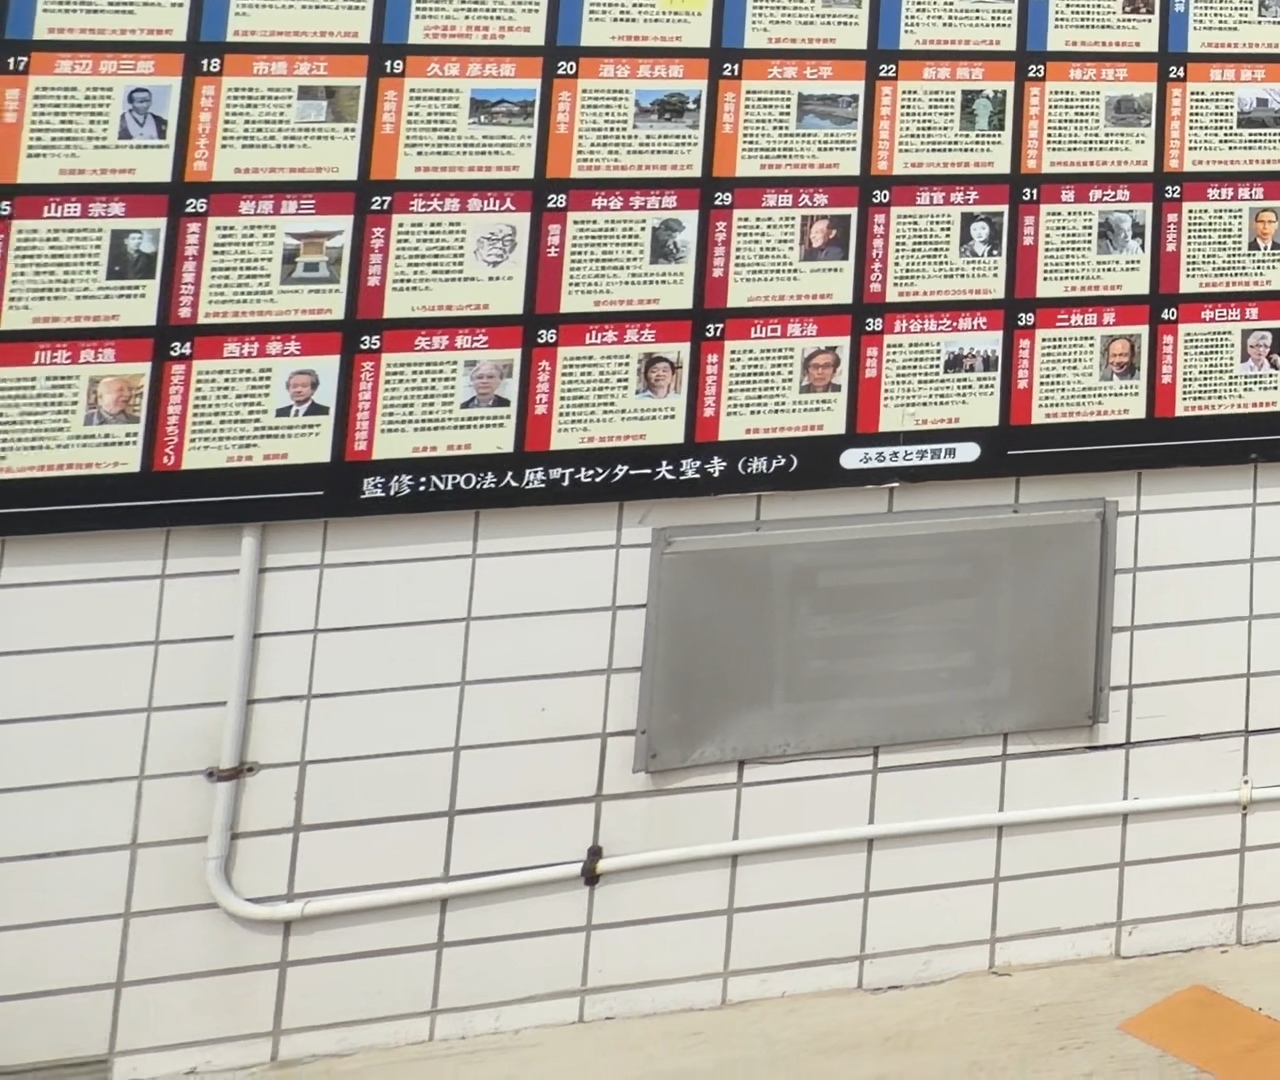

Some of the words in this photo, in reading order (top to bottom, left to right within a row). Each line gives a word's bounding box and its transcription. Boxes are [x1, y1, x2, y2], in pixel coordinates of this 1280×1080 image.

[6, 56, 29, 72] 17
[98, 60, 155, 74] 卯三郎
[200, 58, 221, 72] 18
[252, 61, 287, 75] 市橋
[294, 61, 328, 75] 波江
[384, 60, 403, 74] 19
[426, 63, 460, 77] 久保
[466, 63, 516, 77] 彦兵衛
[558, 61, 576, 74] 20
[722, 63, 739, 76] 21
[636, 64, 683, 78] 長兵衛
[768, 66, 798, 79] 大家
[802, 66, 833, 79] 七平
[879, 65, 896, 77] 22
[922, 66, 951, 80] 新家
[956, 67, 985, 80] 熊吉
[1028, 65, 1045, 77] 23
[1100, 68, 1128, 81] 理平
[1169, 66, 1185, 79] 24
[714, 192, 732, 205] 29
[872, 190, 889, 203] 30
[950, 191, 979, 204] 咲子
[1023, 188, 1038, 200] 31
[1164, 186, 1181, 198] 32
[1207, 188, 1234, 200] 牧野
[1238, 187, 1264, 200] 隆信
[185, 199, 207, 212] 26
[371, 197, 392, 210] 27
[409, 198, 461, 213] 北大路
[466, 198, 517, 212] 魯山人
[547, 195, 566, 208] 28
[591, 196, 623, 210] 中谷
[761, 194, 793, 207] 深田
[798, 193, 829, 207] 久弥
[43, 203, 81, 217] 山田
[88, 203, 126, 217] 宗美
[239, 200, 274, 214] 岩原
[280, 200, 316, 214] 謙三
[1018, 314, 1034, 326] 39
[1103, 313, 1116, 326] 昇
[1161, 308, 1177, 321] 40
[706, 324, 724, 337] 37
[865, 317, 883, 331] 38
[538, 330, 557, 343] 36
[586, 330, 619, 344] 山本
[624, 329, 656, 343] 長左
[750, 324, 781, 338] 山口
[360, 336, 380, 349] 35
[414, 336, 450, 350] 矢野
[454, 334, 489, 349] 和之
[170, 342, 192, 356] 34
[223, 343, 260, 357] 西村
[265, 342, 302, 356] 幸夫
[33, 349, 72, 364] 川北
[859, 445, 957, 465] ふるさと学習用
